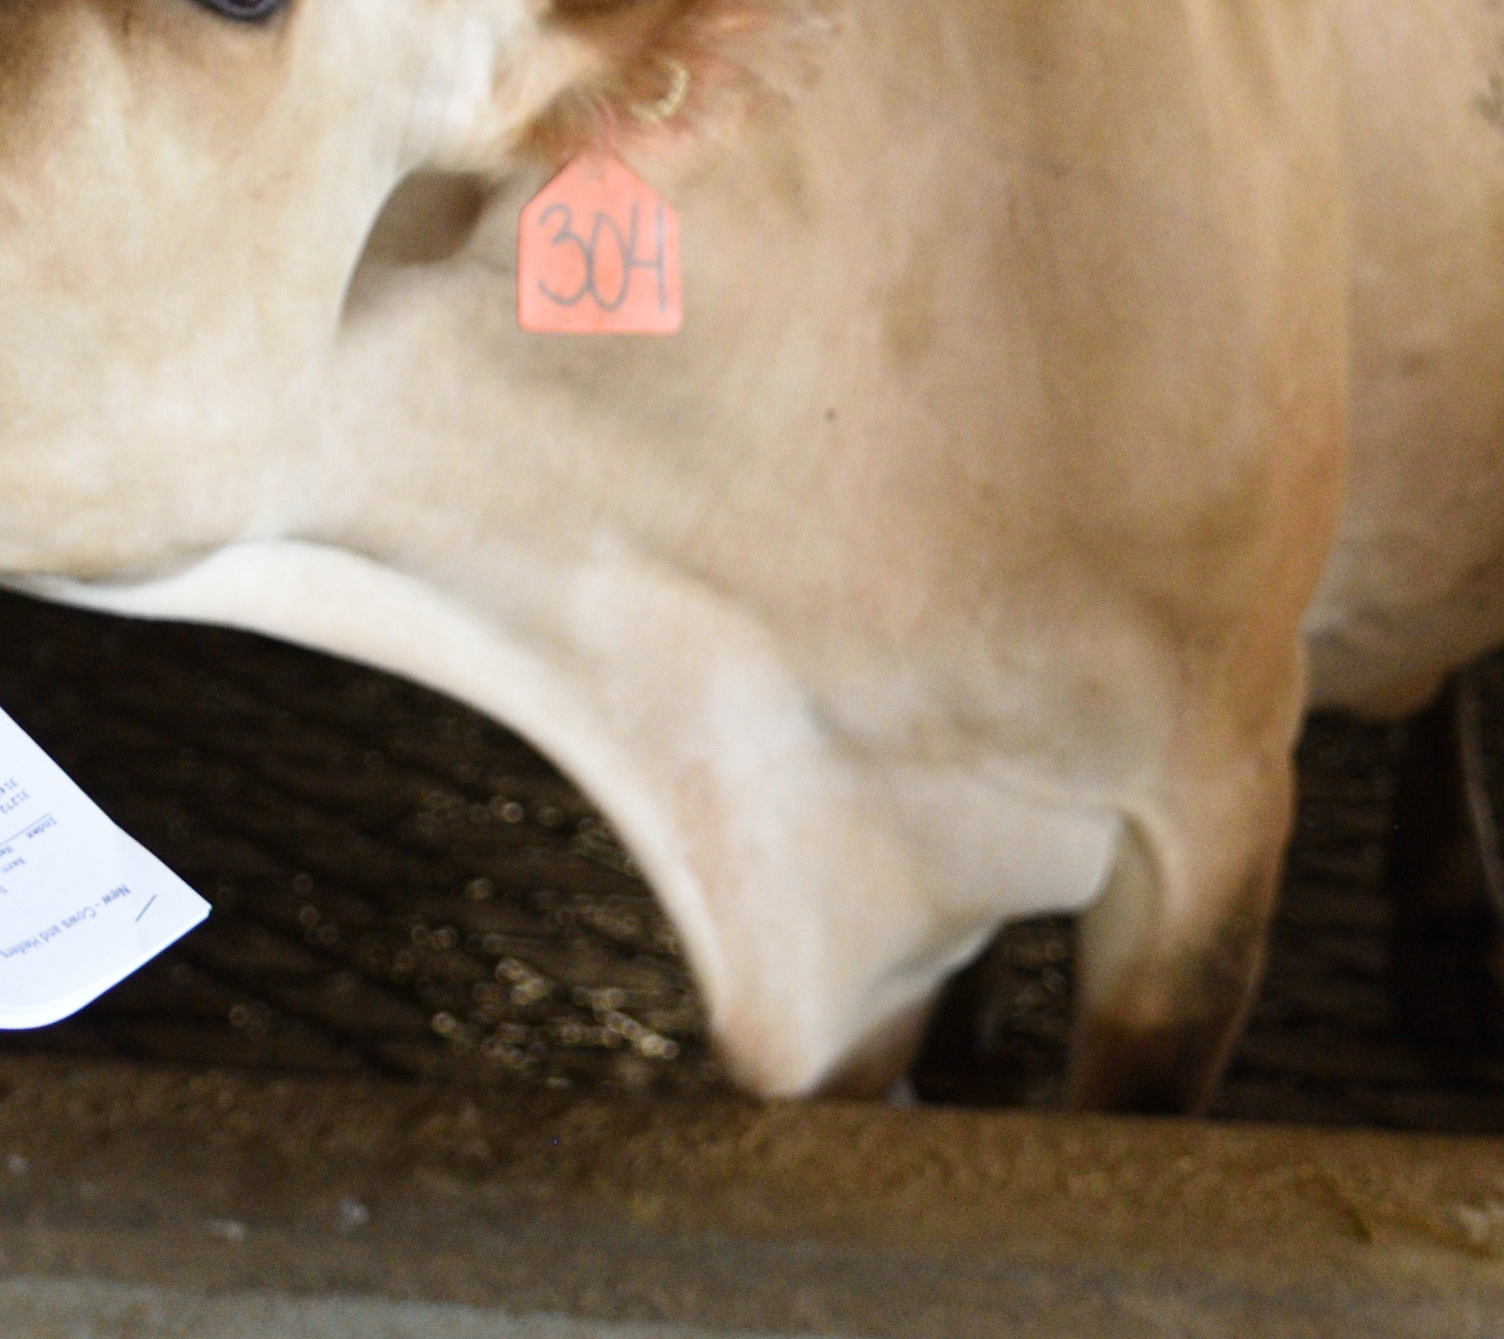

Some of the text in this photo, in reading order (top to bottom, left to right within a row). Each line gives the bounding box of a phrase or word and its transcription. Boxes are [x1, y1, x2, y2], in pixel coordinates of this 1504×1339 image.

[525, 186, 630, 275] 304
[22, 816, 58, 839] Index
[1, 857, 27, 873] Barn
[101, 883, 132, 905] New
[60, 906, 97, 929] Cows
[38, 924, 62, 943] and
[0, 936, 42, 959] Heifers
